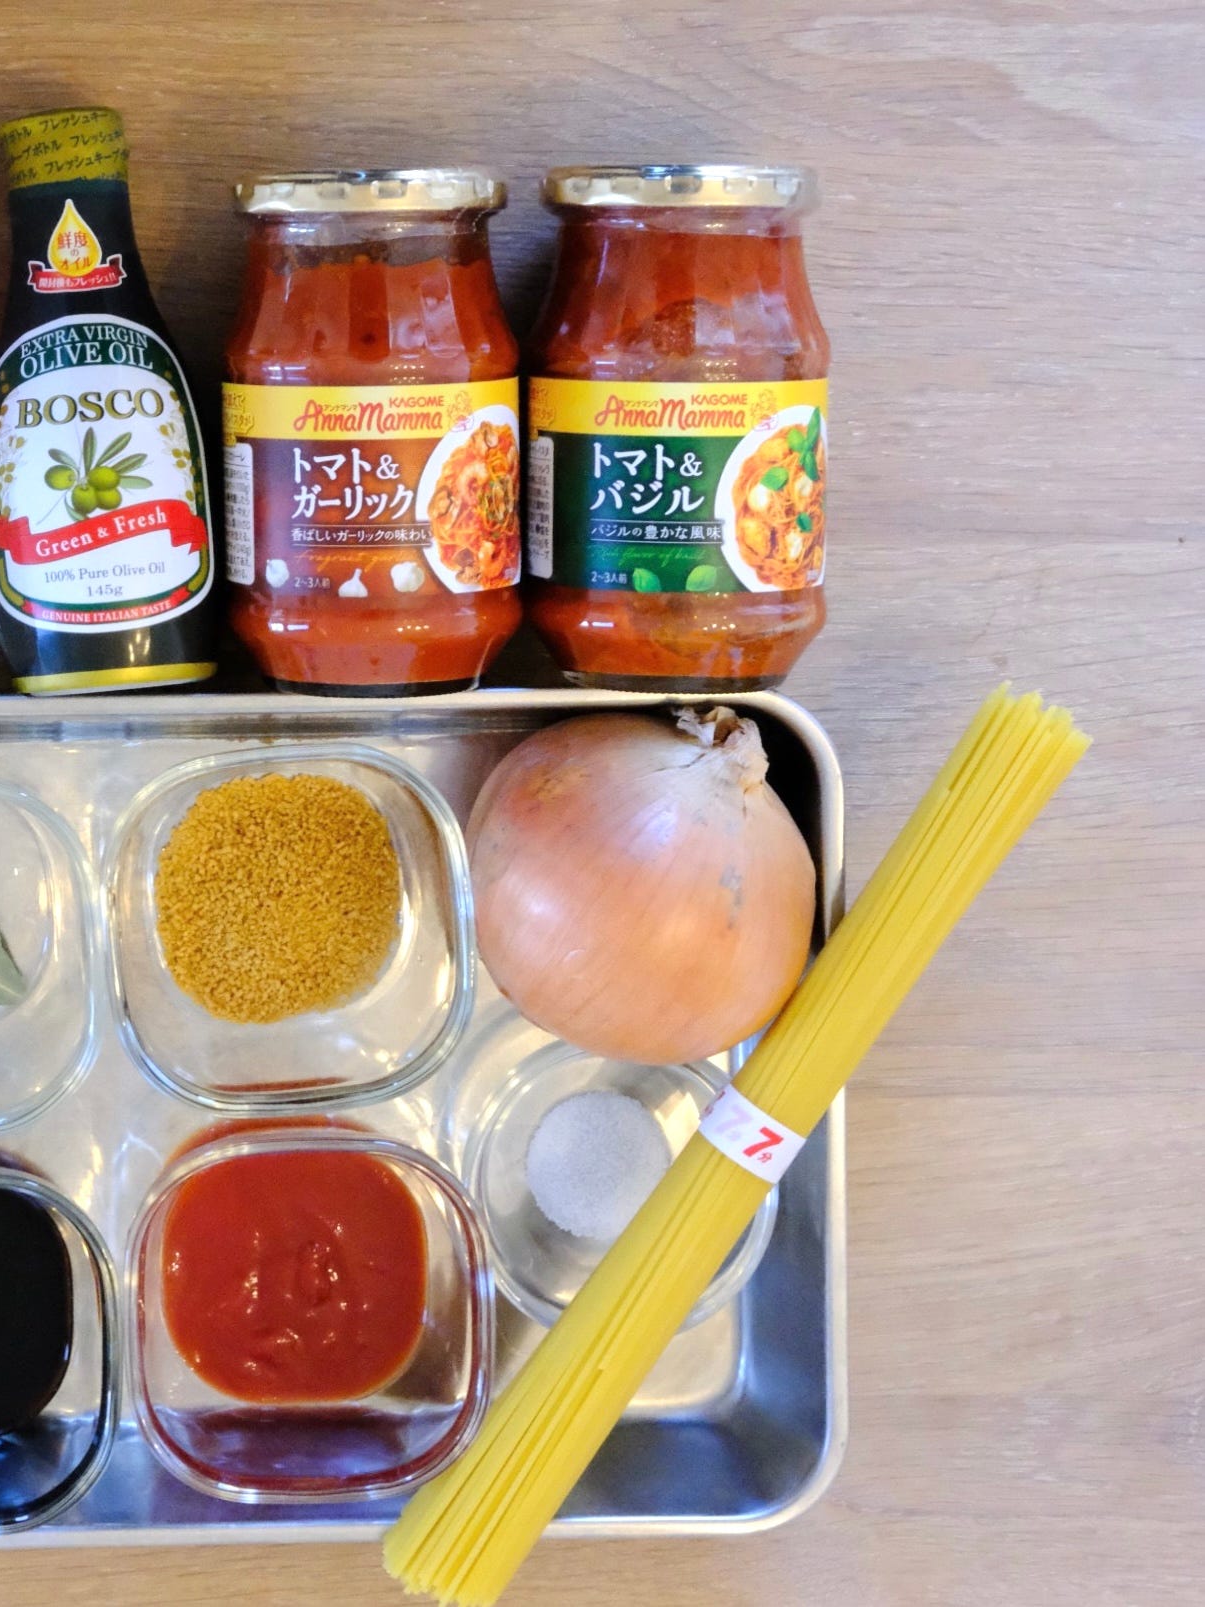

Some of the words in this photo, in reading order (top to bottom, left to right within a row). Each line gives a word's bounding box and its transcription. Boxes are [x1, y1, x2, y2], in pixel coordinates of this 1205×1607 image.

[57, 231, 88, 249] 鮮度
[60, 255, 91, 270] オイル
[20, 326, 79, 359] EXTRA
[82, 325, 148, 350] VIRGIN
[20, 343, 102, 379] OLIVE
[109, 341, 153, 370] OIL
[15, 388, 165, 429] BOSCO
[389, 396, 444, 408] KAGOME
[691, 394, 747, 406] KAGOME
[293, 447, 400, 484] トマト&
[592, 442, 702, 481] トマト&
[291, 484, 414, 520] ガーリック
[589, 479, 705, 516] バジル
[35, 531, 93, 558] Green
[97, 526, 110, 539] &
[113, 506, 168, 535] Fresh
[290, 528, 433, 542] 香ばしいガーリックの味わい
[590, 524, 722, 540] バジルの豊かな風味
[44, 568, 76, 584] 100%
[79, 567, 109, 580] Pure
[112, 564, 145, 577] Olive
[148, 561, 166, 574] Oil
[87, 585, 123, 598] 145g
[41, 609, 91, 623] GENUINE
[93, 609, 139, 623] ITALIAN
[141, 600, 173, 617] TASTE
